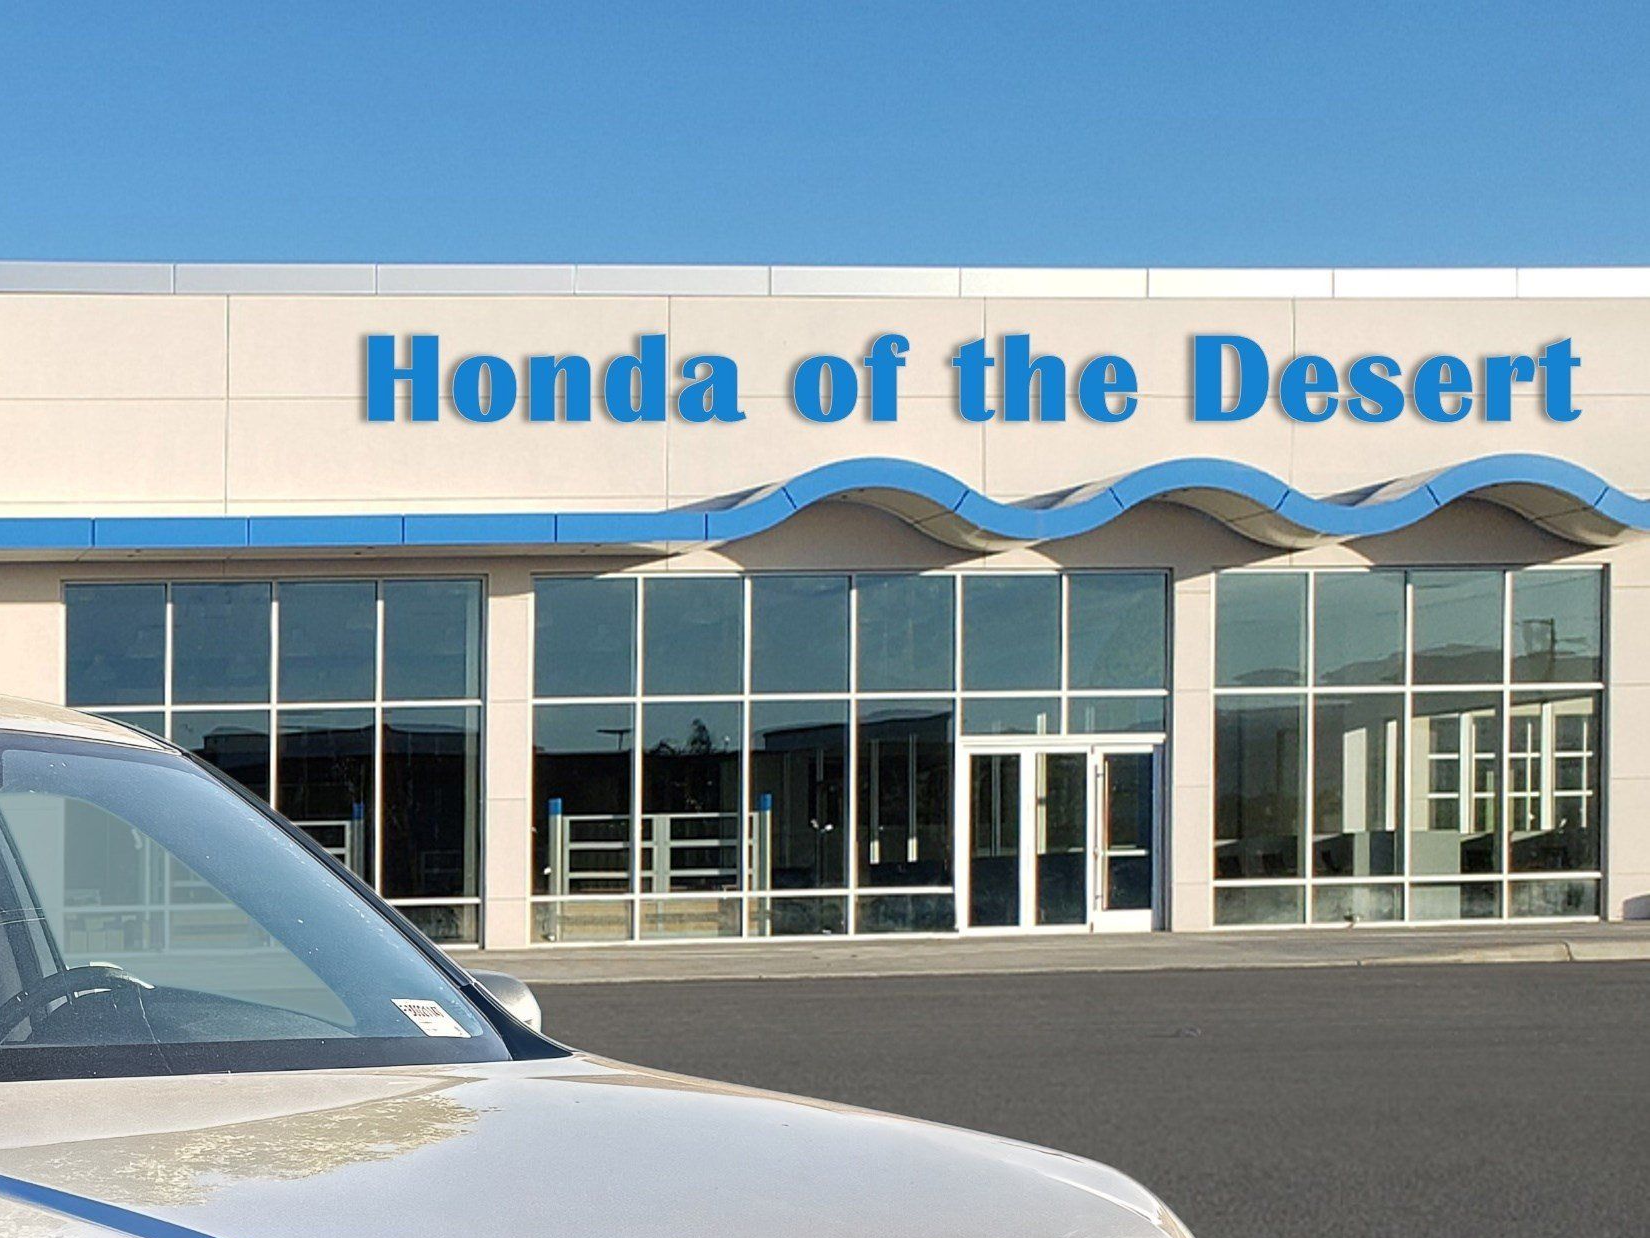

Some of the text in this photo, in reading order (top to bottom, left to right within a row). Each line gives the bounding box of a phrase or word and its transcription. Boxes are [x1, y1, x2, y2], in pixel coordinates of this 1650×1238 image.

[365, 333, 1583, 424] Honda of the Desert
